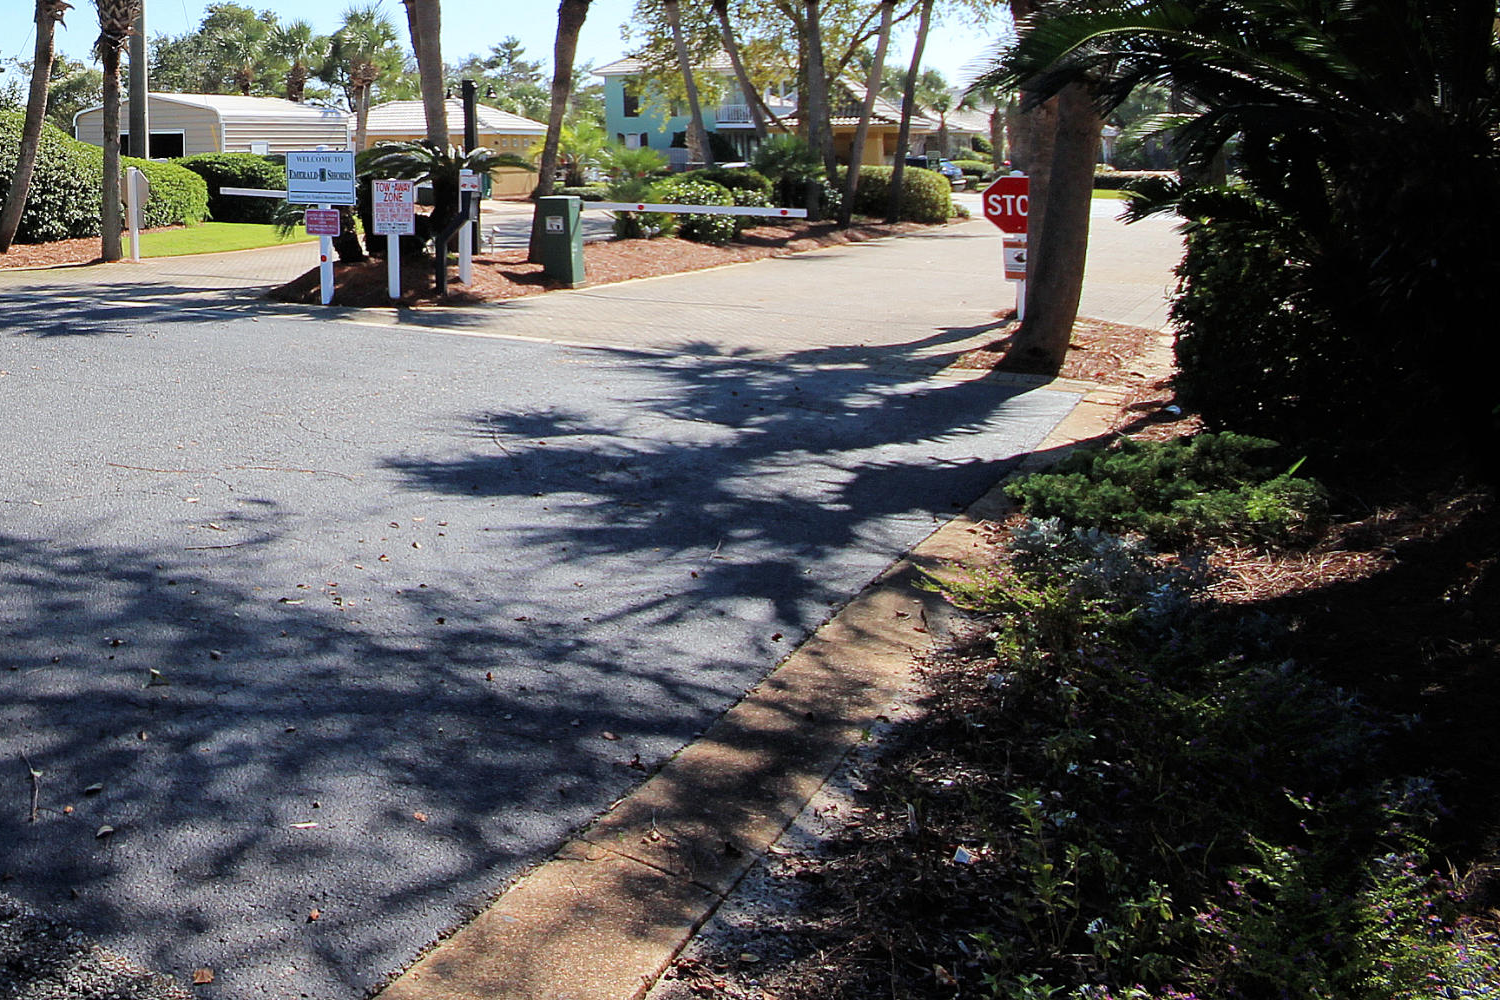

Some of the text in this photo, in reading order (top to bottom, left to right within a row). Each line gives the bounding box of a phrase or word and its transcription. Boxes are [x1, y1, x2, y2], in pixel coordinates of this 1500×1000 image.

[296, 155, 332, 163] WELCOME
[289, 169, 318, 180] EMERALD
[383, 192, 403, 202] ZONE
[987, 194, 1029, 216] STO
